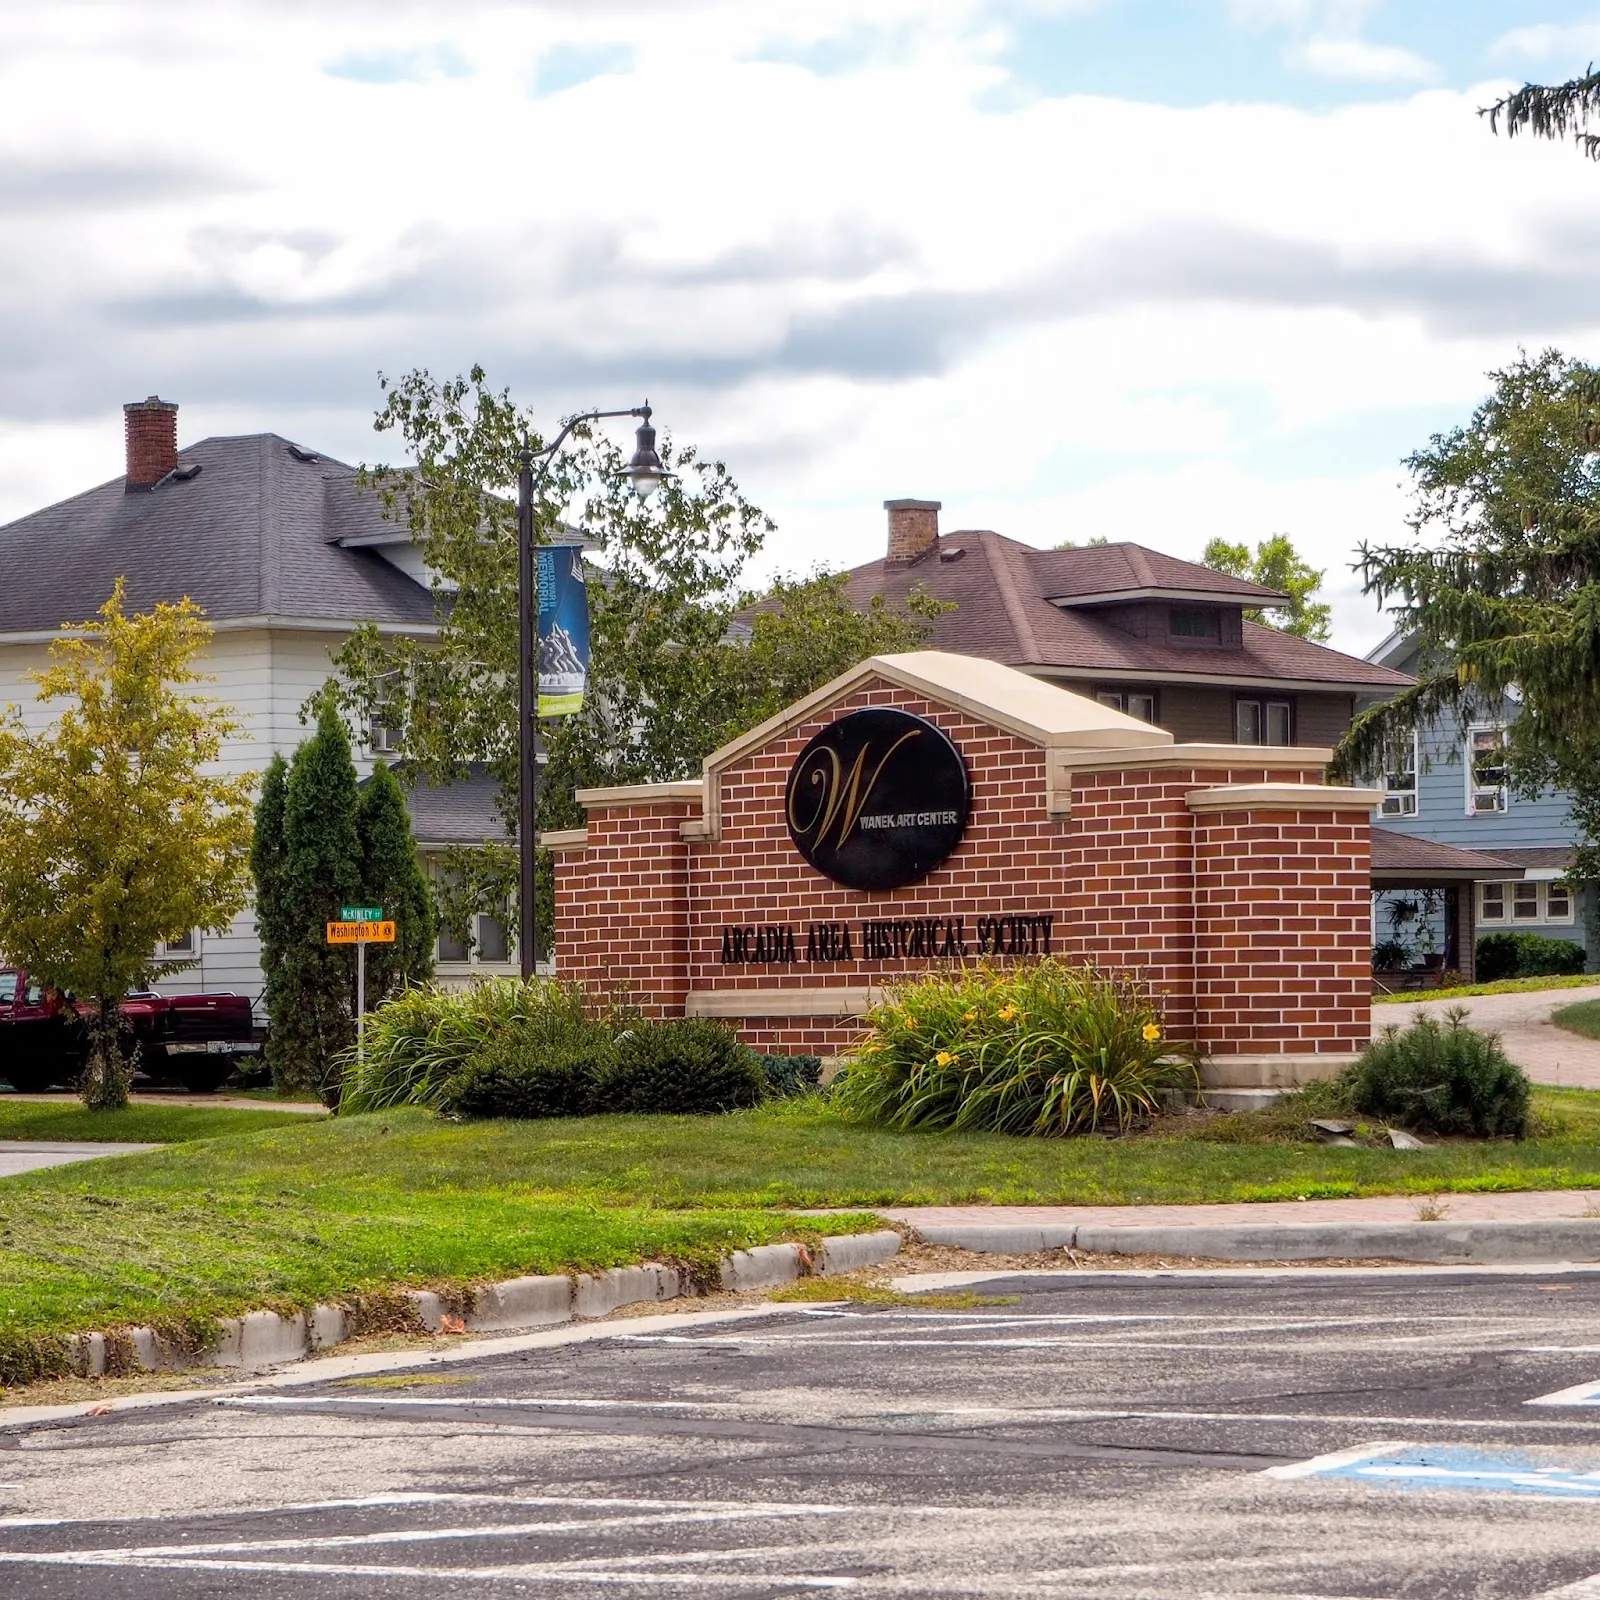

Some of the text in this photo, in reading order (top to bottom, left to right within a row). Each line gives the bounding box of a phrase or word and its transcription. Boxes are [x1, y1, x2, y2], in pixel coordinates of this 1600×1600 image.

[538, 551, 549, 615] MEMORIAL
[548, 581, 557, 600] WAR
[860, 811, 958, 829] WANEK ART CENTER
[342, 909, 372, 920] McKINLEY
[330, 922, 380, 941] Washington St
[721, 915, 1053, 963] ARCADIA AREA HISTORICAL SOCIETY
